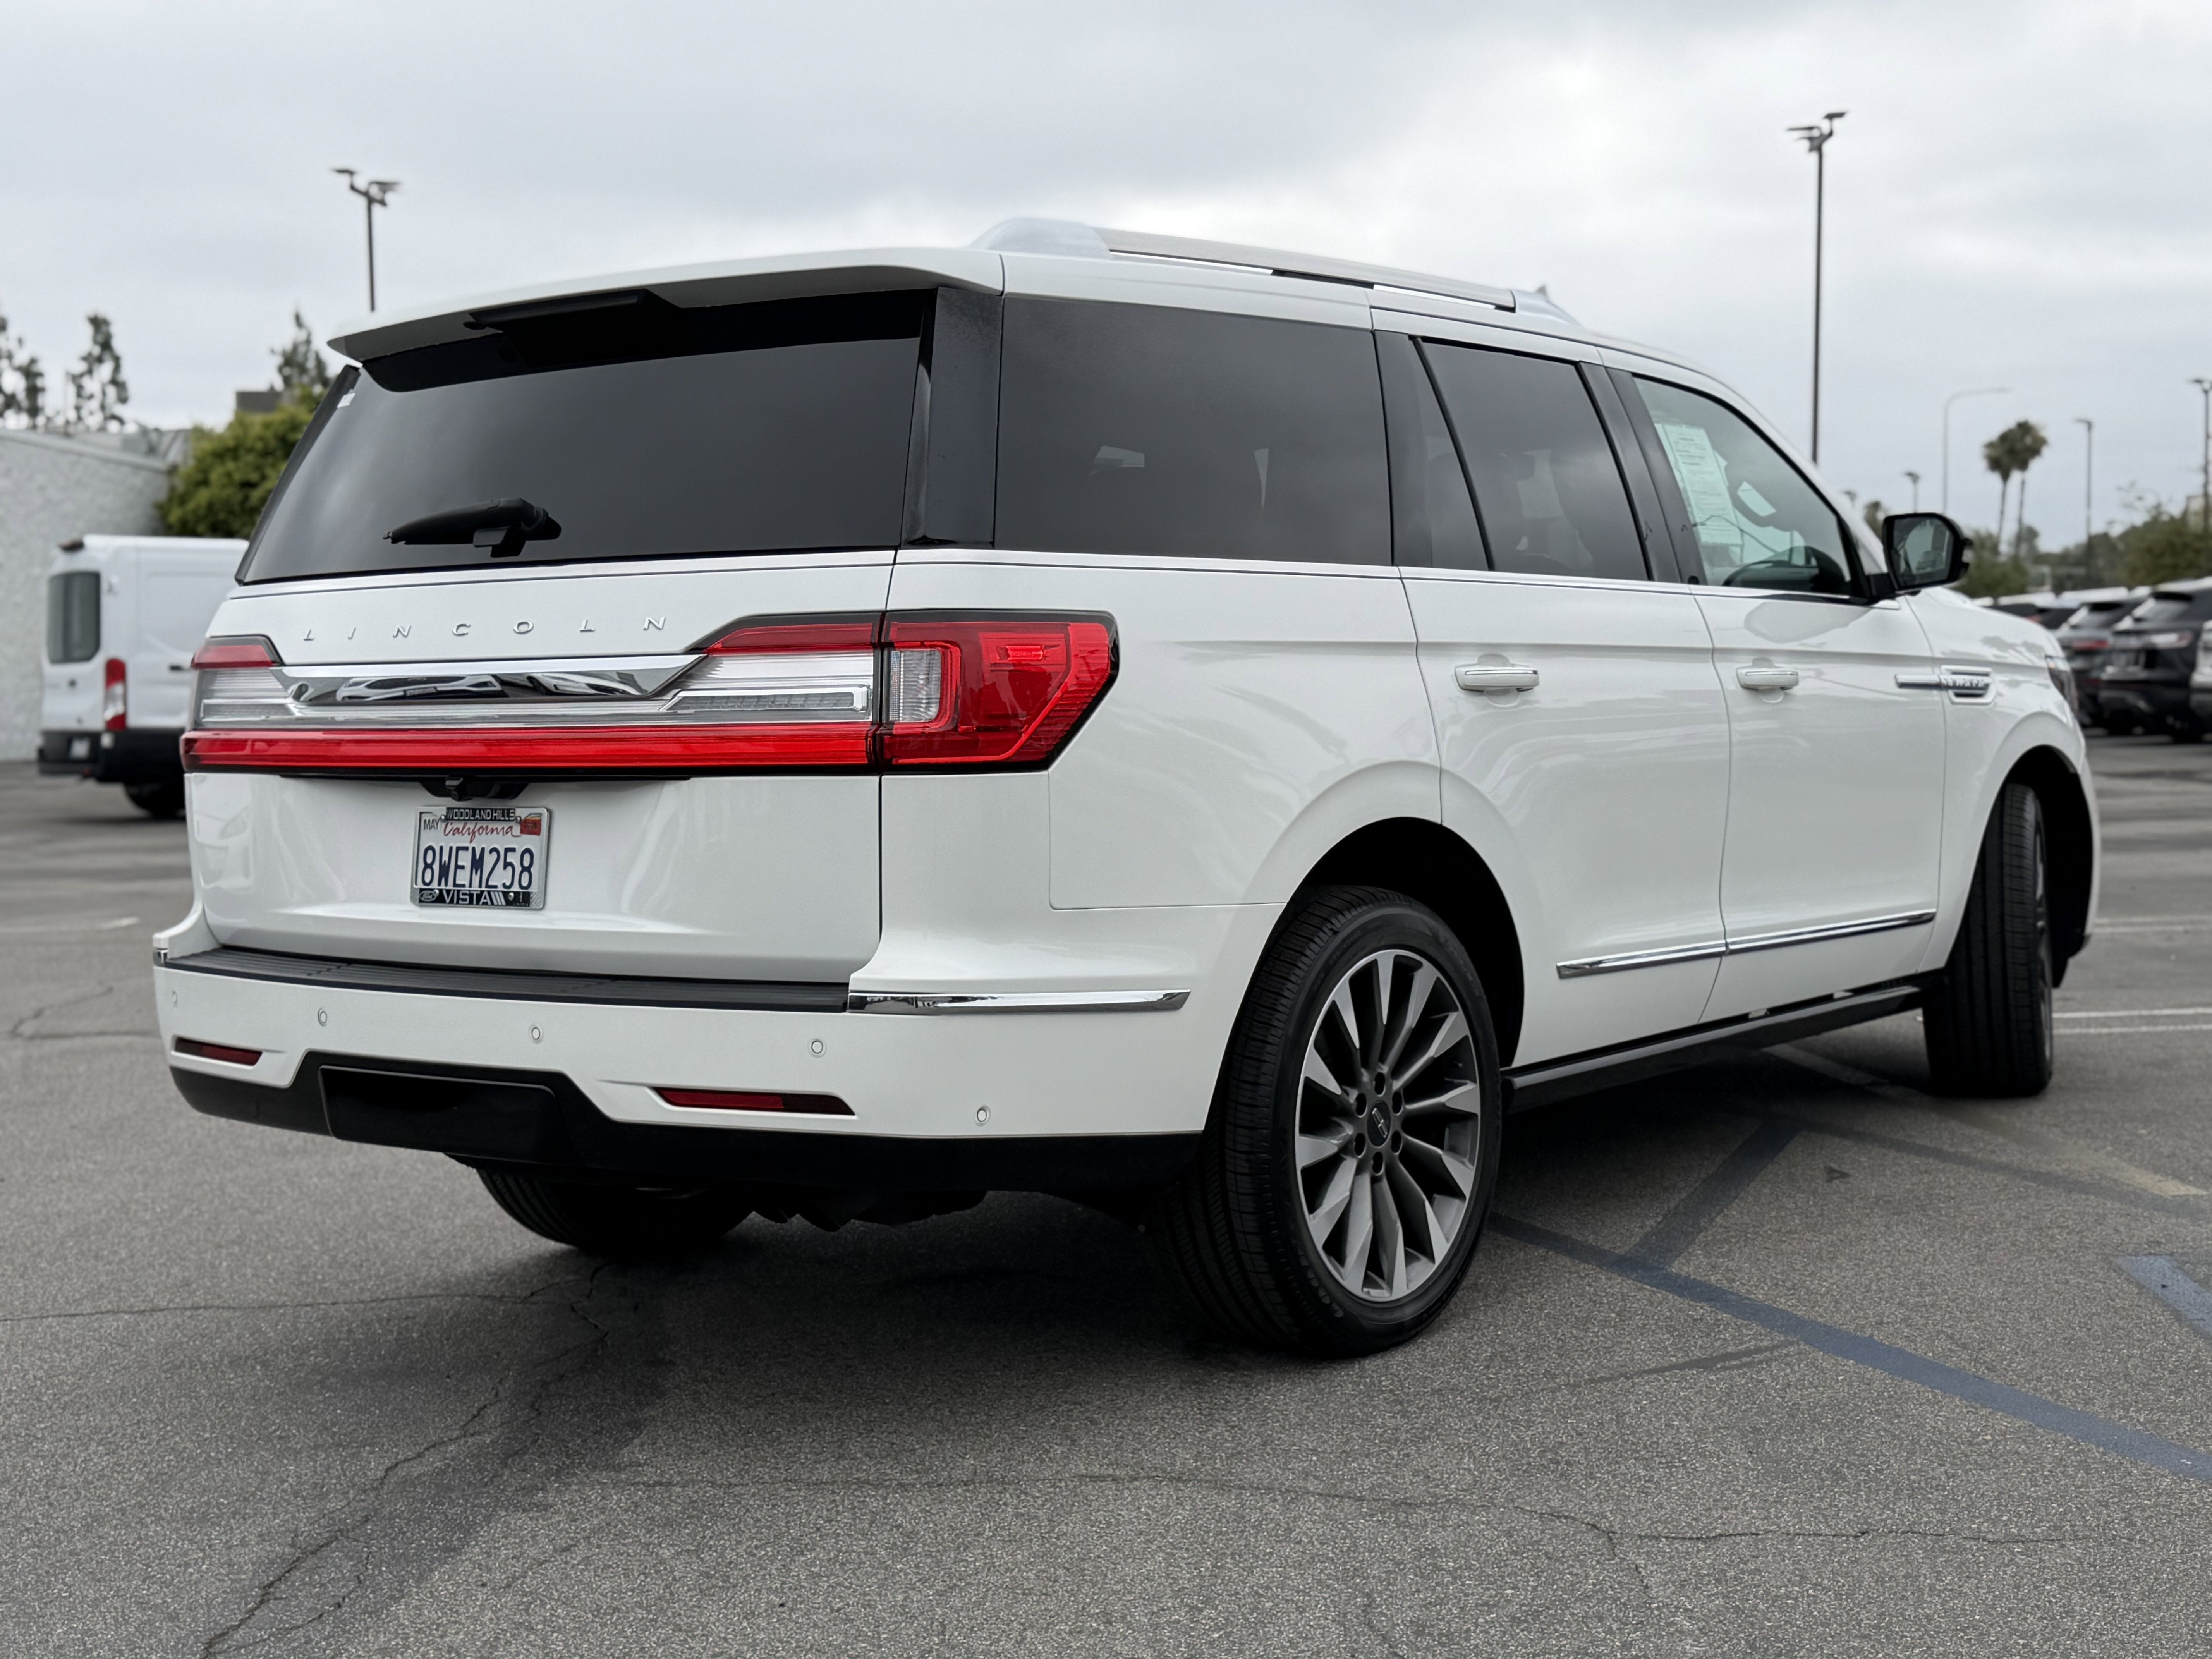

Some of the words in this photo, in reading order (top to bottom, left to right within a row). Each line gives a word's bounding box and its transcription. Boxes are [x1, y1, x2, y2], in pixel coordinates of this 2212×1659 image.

[303, 617, 666, 641] LINCOLN
[447, 809, 491, 820] WOODLAND
[492, 809, 515, 820] HILLS
[424, 819, 439, 831] MAY
[444, 821, 521, 843] California
[422, 845, 534, 890] 8WEM258
[443, 889, 491, 905] VISTA
